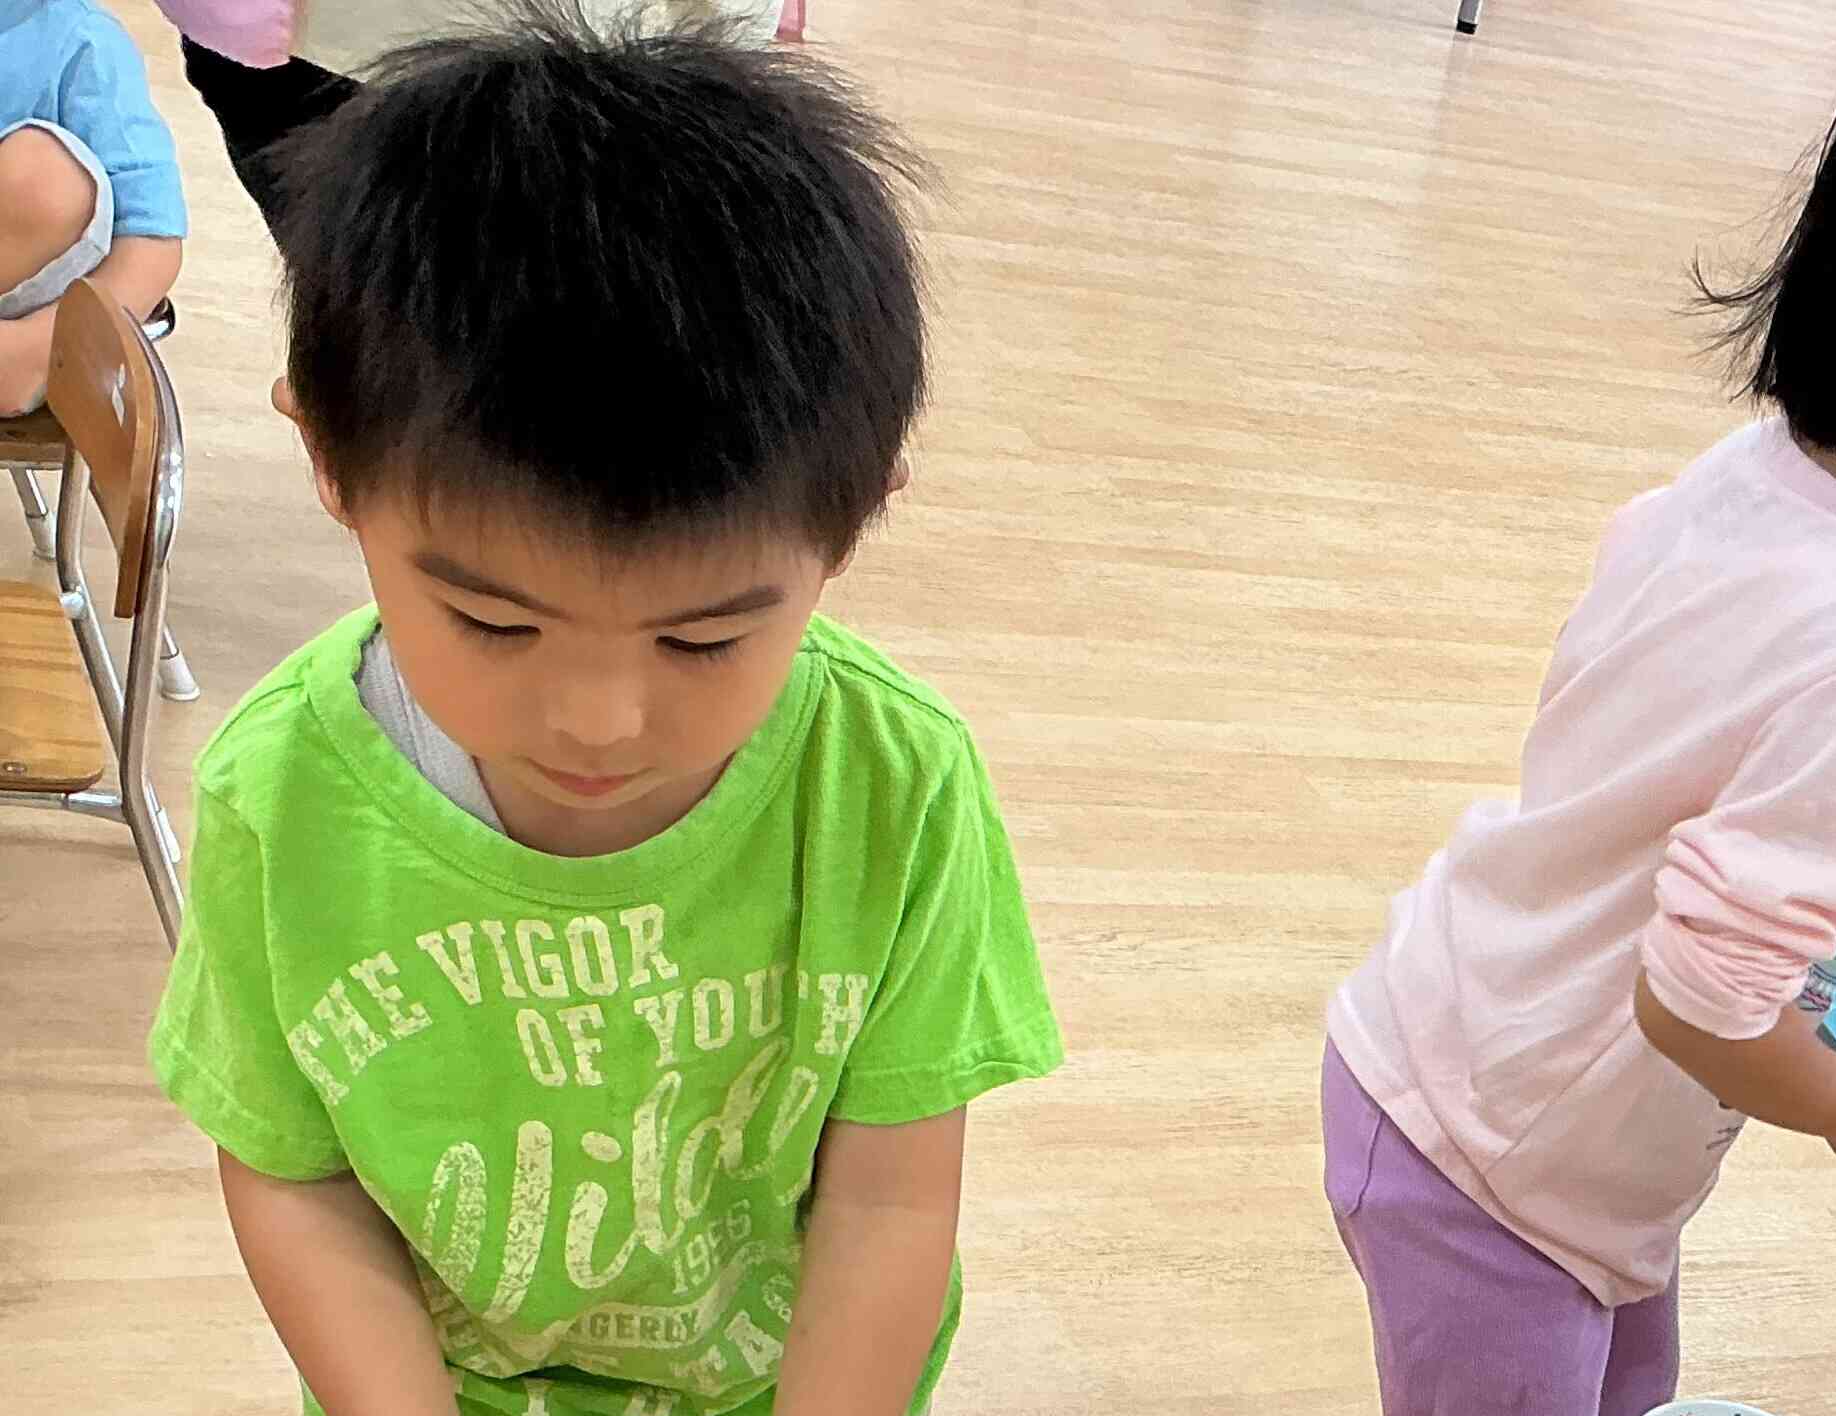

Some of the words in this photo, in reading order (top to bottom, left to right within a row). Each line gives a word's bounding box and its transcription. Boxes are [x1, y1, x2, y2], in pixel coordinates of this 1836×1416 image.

[288, 952, 432, 1105] THE
[416, 904, 679, 1006] VIGOR
[516, 1003, 607, 1086] OF
[634, 962, 868, 1068] YOUH
